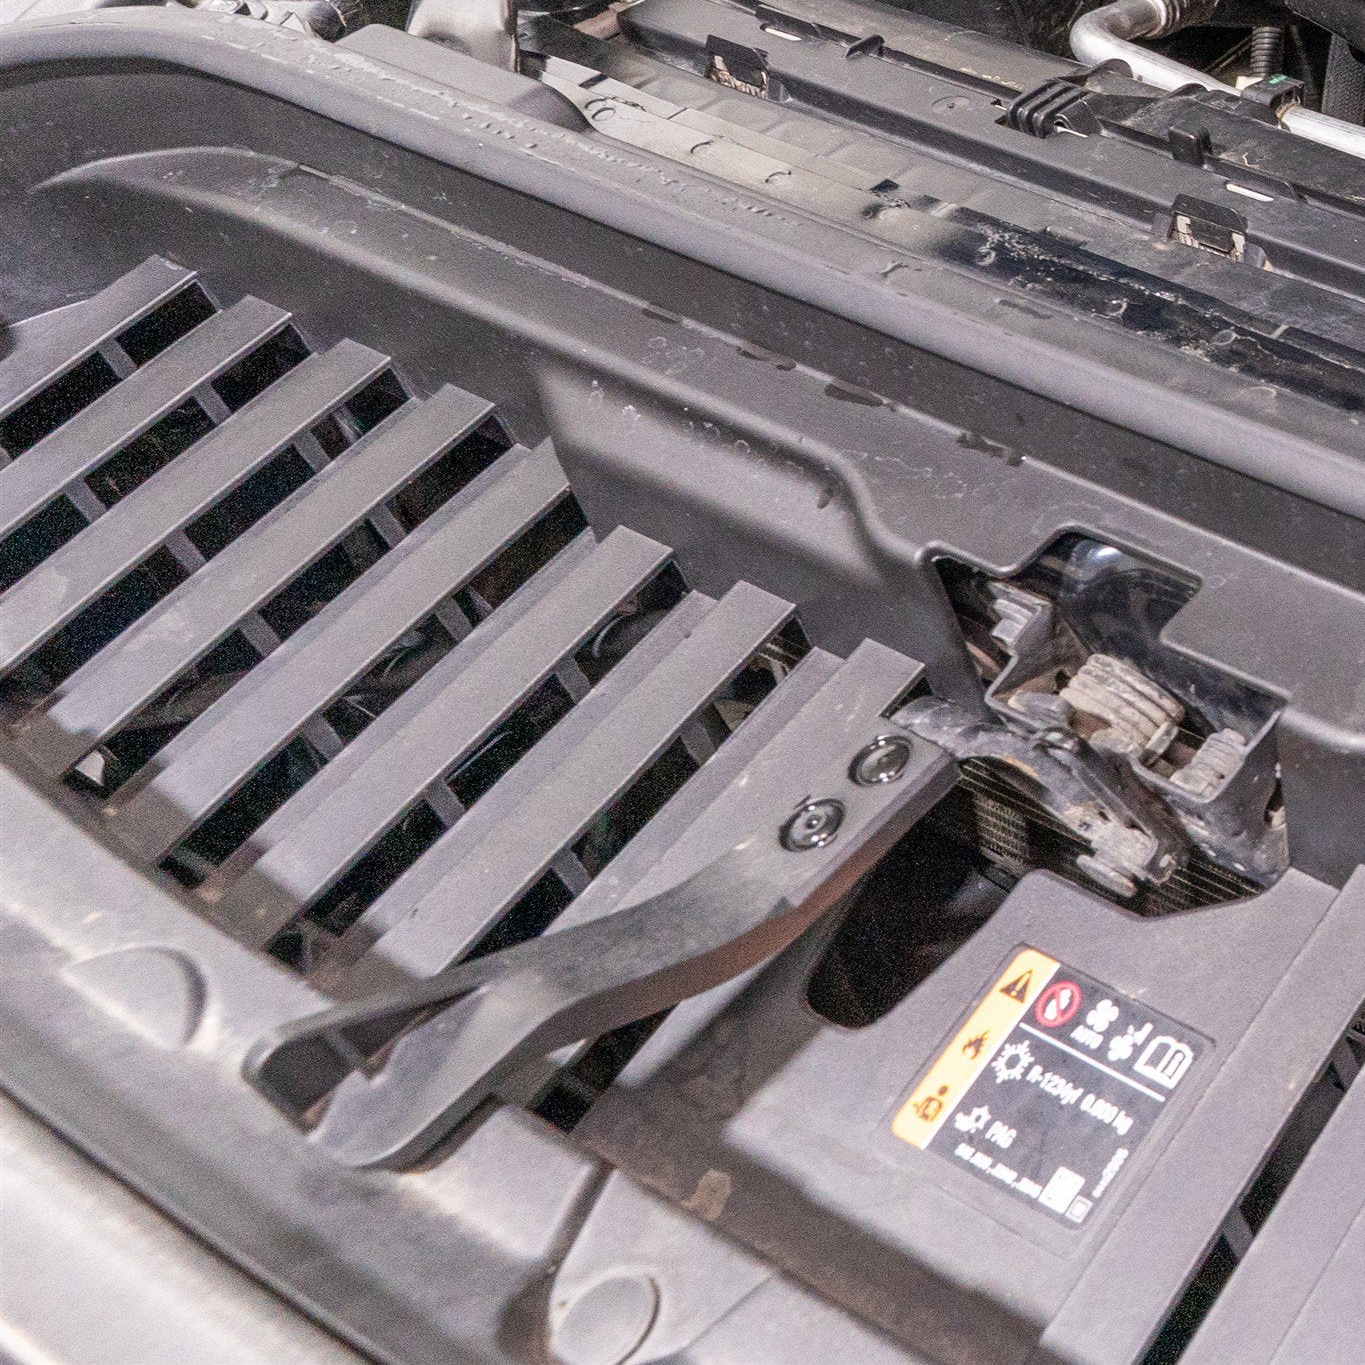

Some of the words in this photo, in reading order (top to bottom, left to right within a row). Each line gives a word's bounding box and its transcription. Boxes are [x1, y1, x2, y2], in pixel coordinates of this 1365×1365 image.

[1070, 1025, 1103, 1049] AUTO
[1026, 1065, 1084, 1104] R-1234yf
[1112, 1111, 1134, 1136] kg
[985, 1121, 1017, 1149] PAG
